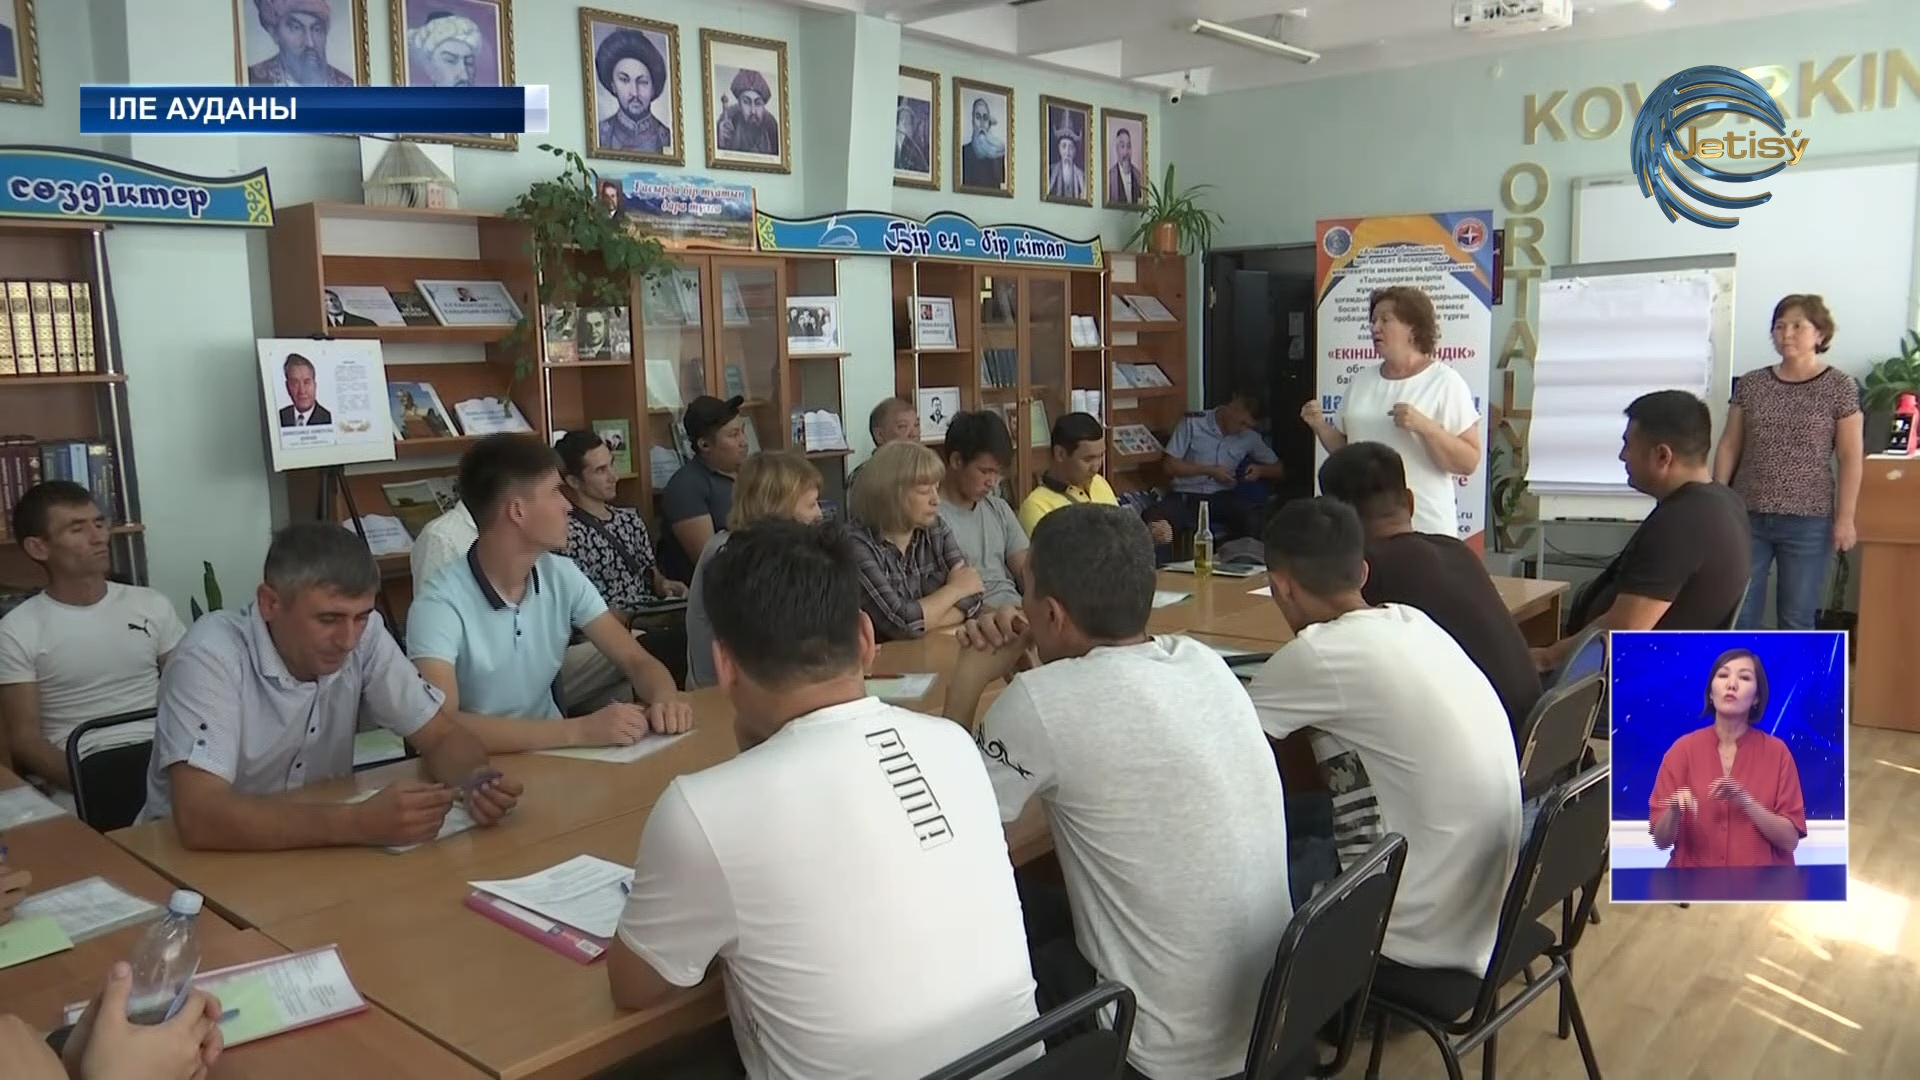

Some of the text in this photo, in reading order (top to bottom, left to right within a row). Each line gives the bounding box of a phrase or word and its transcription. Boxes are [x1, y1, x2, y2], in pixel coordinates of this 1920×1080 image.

[9, 174, 209, 217] сөздіктер
[885, 222, 930, 256] Бір
[938, 231, 960, 250] ел
[981, 229, 1009, 262] бір
[1015, 232, 1065, 260] кітап
[1328, 347, 1475, 361] «ЕКІНШ НДІК»
[865, 728, 954, 851] PUMA
